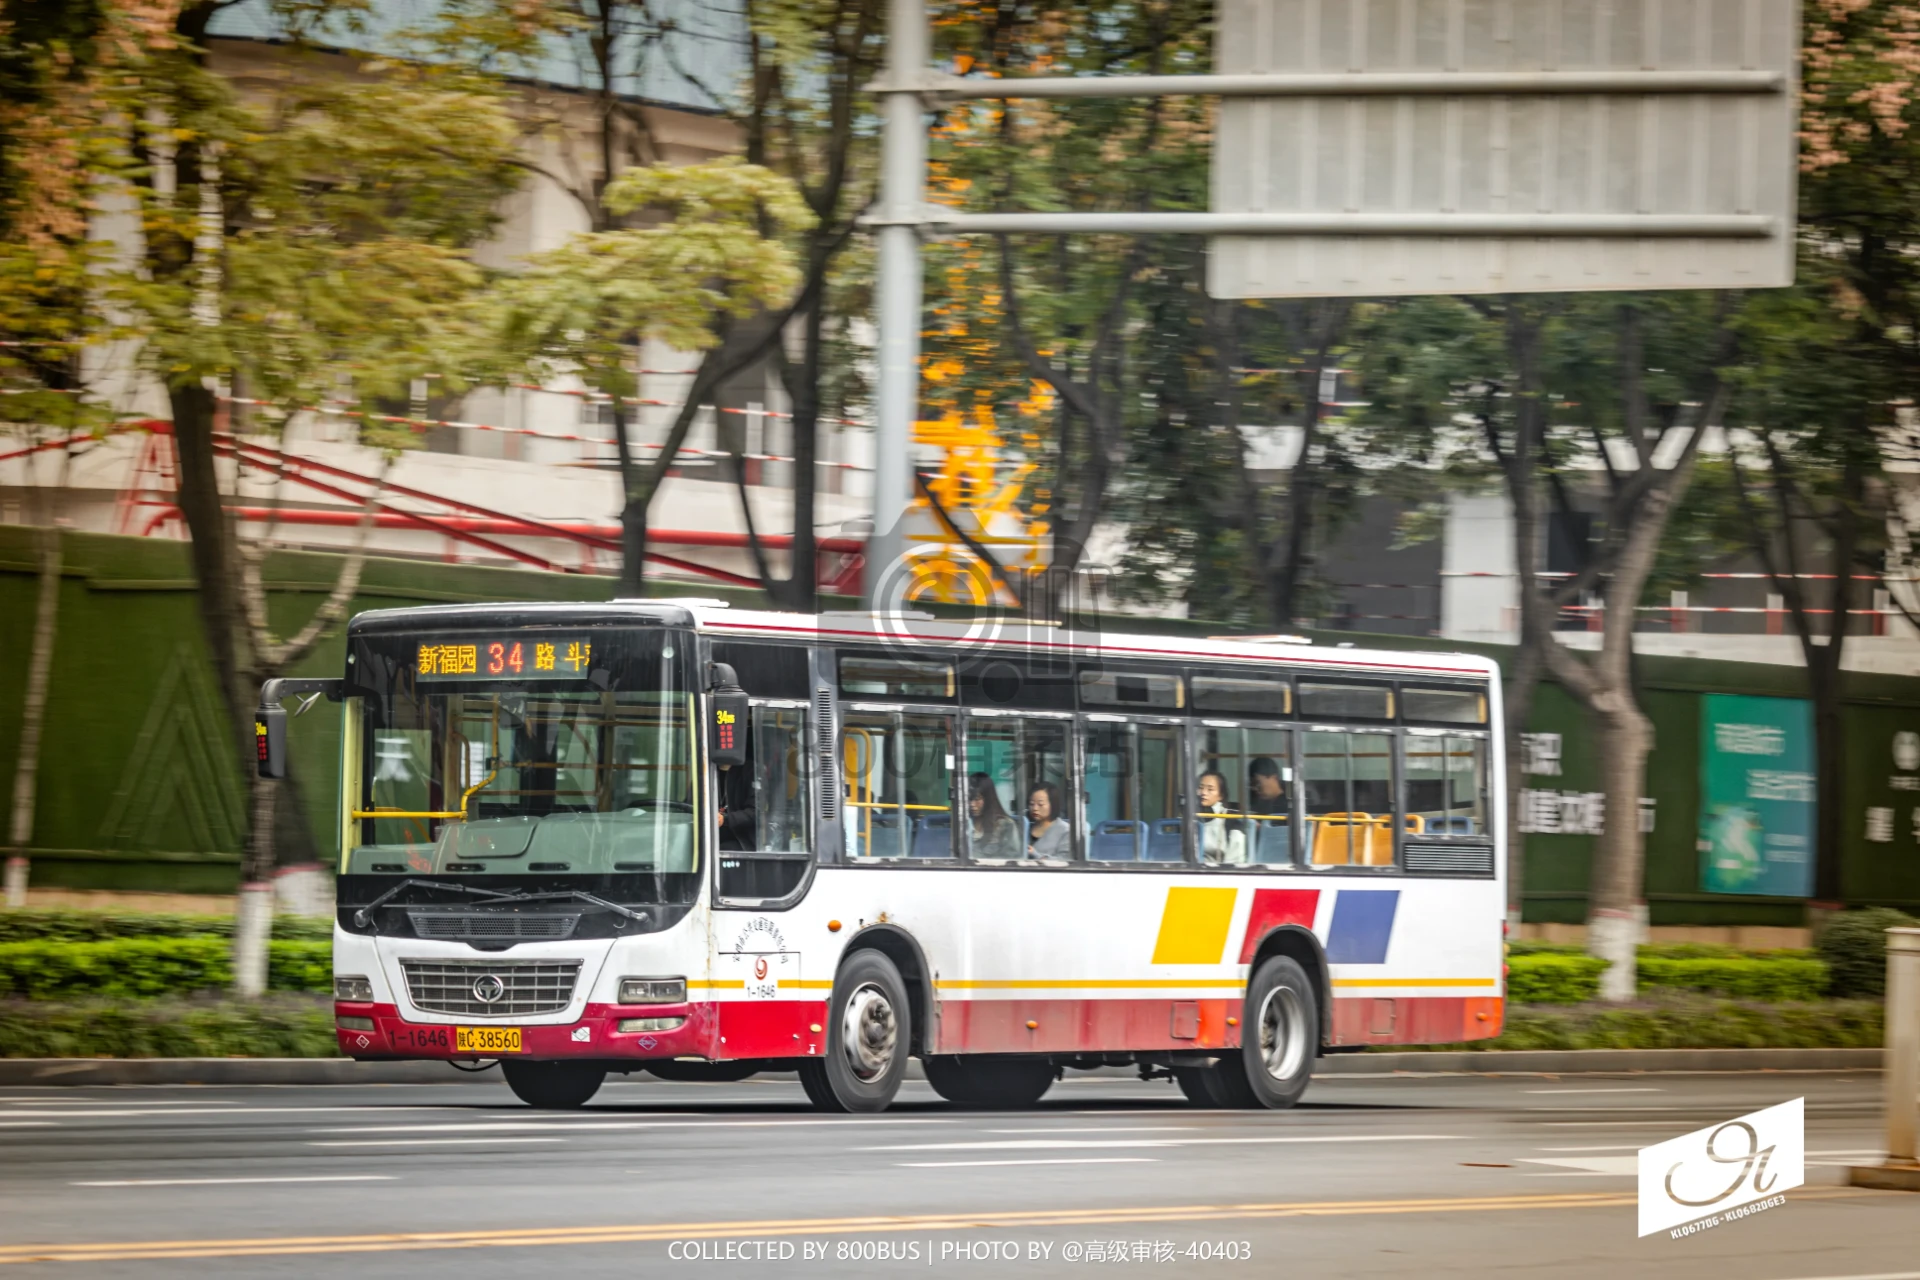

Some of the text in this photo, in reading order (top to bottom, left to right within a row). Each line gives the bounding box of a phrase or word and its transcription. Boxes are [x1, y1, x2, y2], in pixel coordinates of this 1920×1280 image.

[418, 644, 477, 675] 新福园
[488, 641, 524, 674] 34
[535, 642, 556, 670] 路
[747, 984, 776, 999] 1-1646
[389, 1030, 448, 1047] 1-1646
